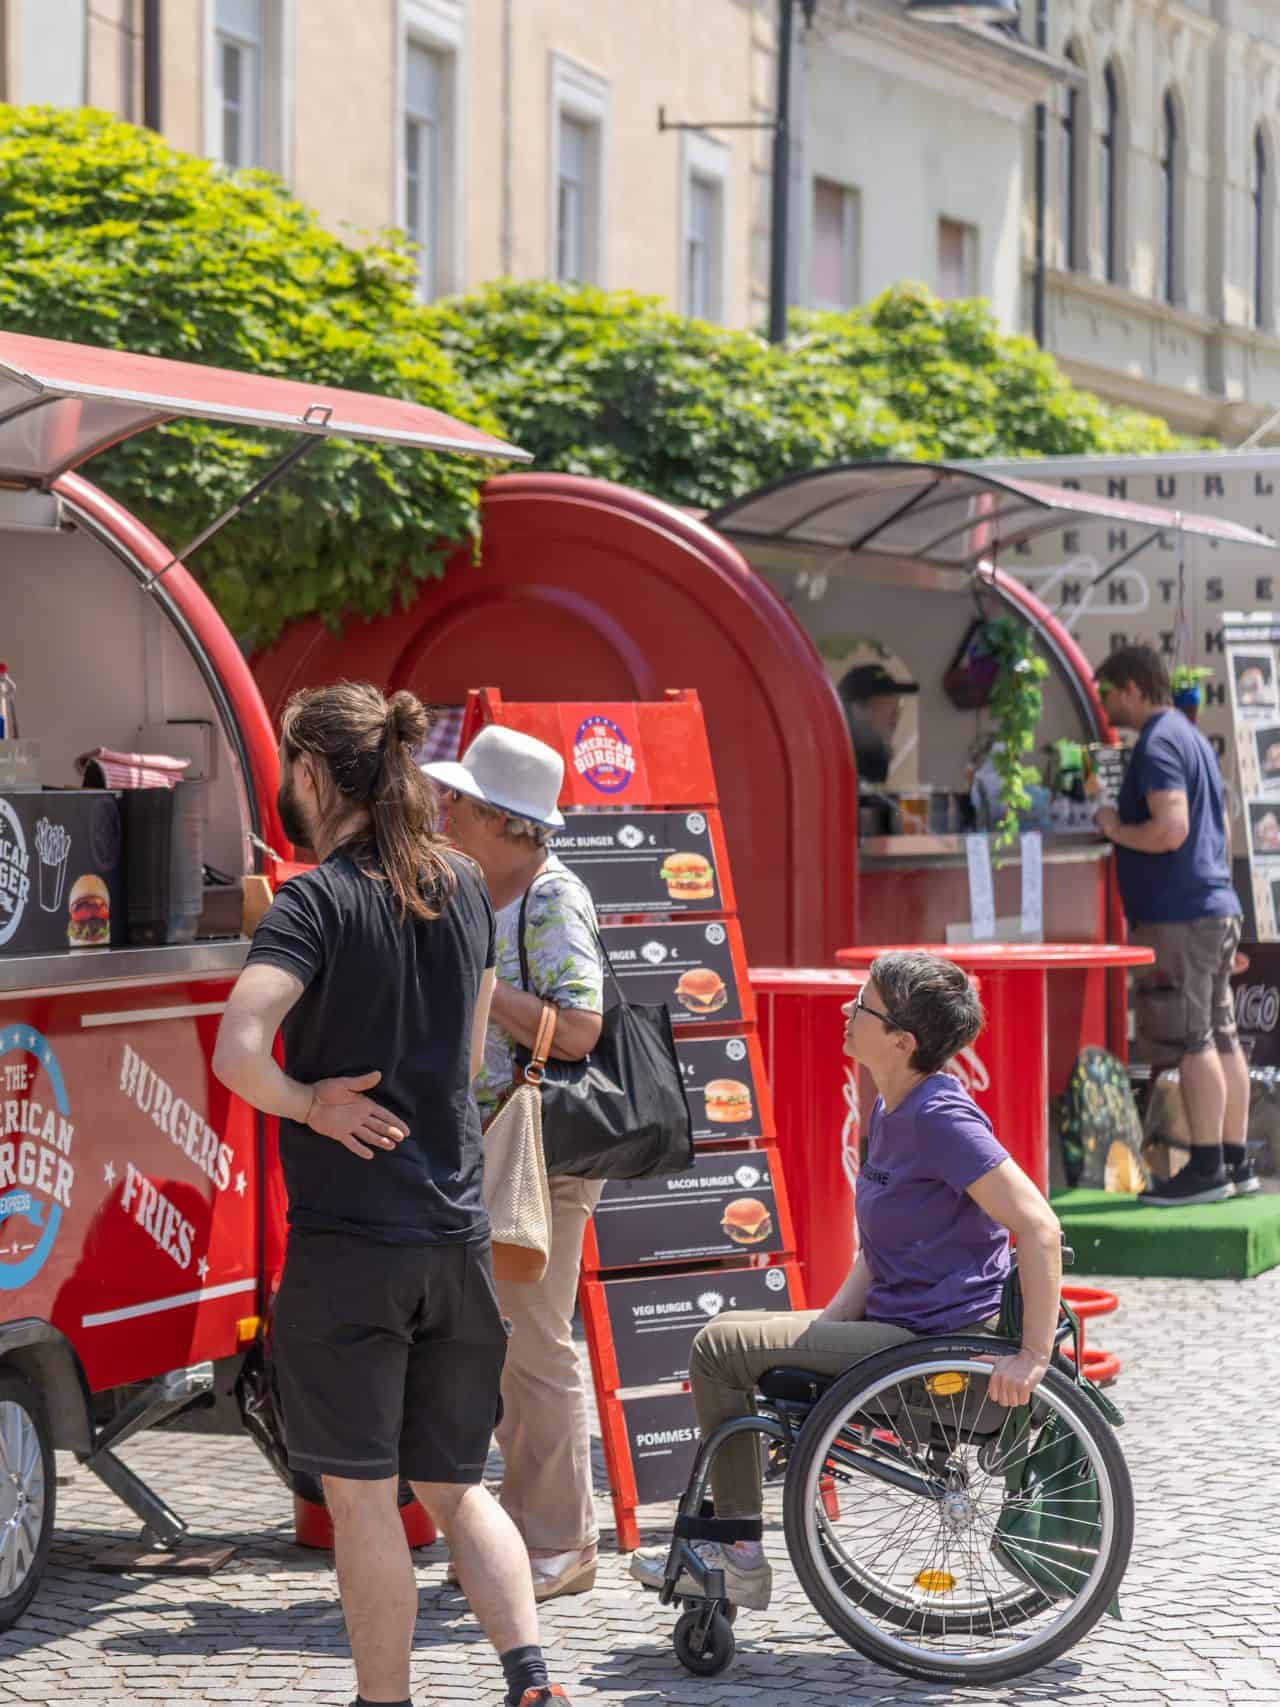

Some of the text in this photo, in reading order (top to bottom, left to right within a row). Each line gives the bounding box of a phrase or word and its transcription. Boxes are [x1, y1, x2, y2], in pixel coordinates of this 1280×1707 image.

[573, 736, 633, 759] AMERICAN
[573, 749, 636, 775] BURGER
[577, 836, 615, 847] BURGER
[3, 1063, 29, 1092] THE
[120, 1044, 234, 1191] BURGERS
[666, 1178, 699, 1191] BACON
[700, 1175, 736, 1187] BURGER
[121, 1162, 196, 1270] FRIES
[631, 1304, 655, 1317] VEGI
[655, 1301, 694, 1314] BURGER
[636, 1429, 693, 1448] POMMES
